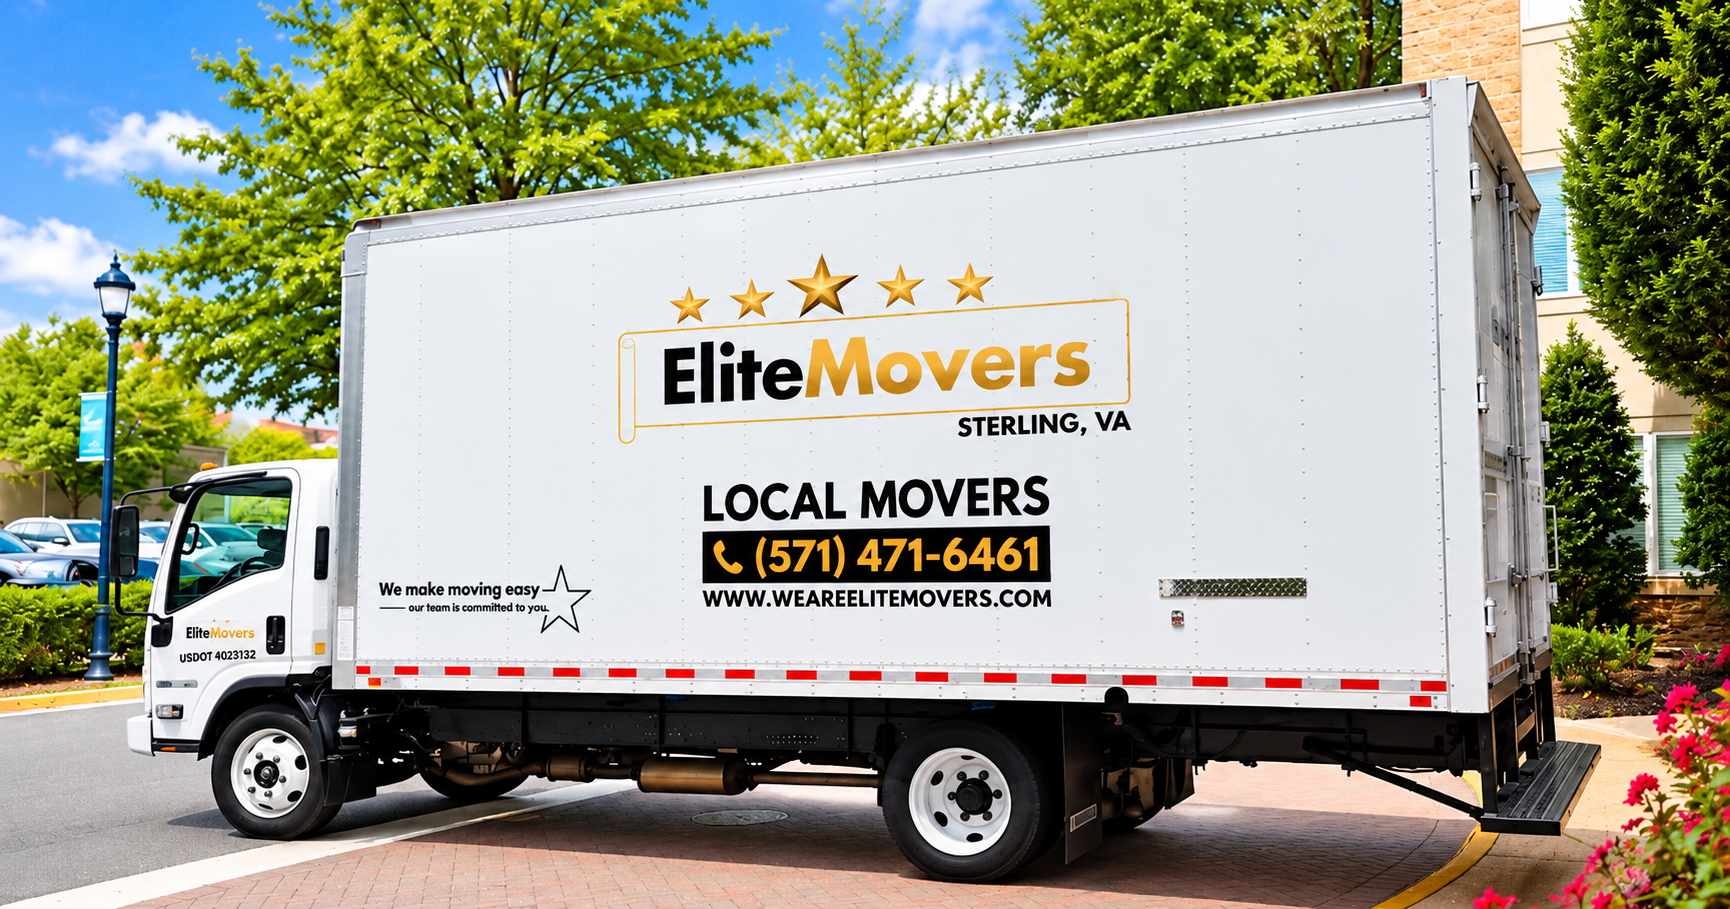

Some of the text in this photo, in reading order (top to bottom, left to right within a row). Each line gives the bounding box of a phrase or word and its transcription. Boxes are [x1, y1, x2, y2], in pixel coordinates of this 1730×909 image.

[663, 336, 1091, 406] EliteMovers
[957, 410, 1132, 438] STERLING, VA
[703, 475, 1050, 522] LOCAL MOVERS
[755, 534, 1039, 580] (571) 471-6461
[378, 581, 541, 601] We make moving easy
[702, 588, 1052, 608] WWW.WEAREELITEMOVERS.COM
[408, 604, 425, 613] our
[426, 603, 451, 613] team
[452, 602, 461, 613] is
[461, 602, 514, 613] committed
[515, 603, 526, 613] to
[185, 626, 255, 639] EliteMovers
[179, 649, 257, 664] USDOT 4023132
